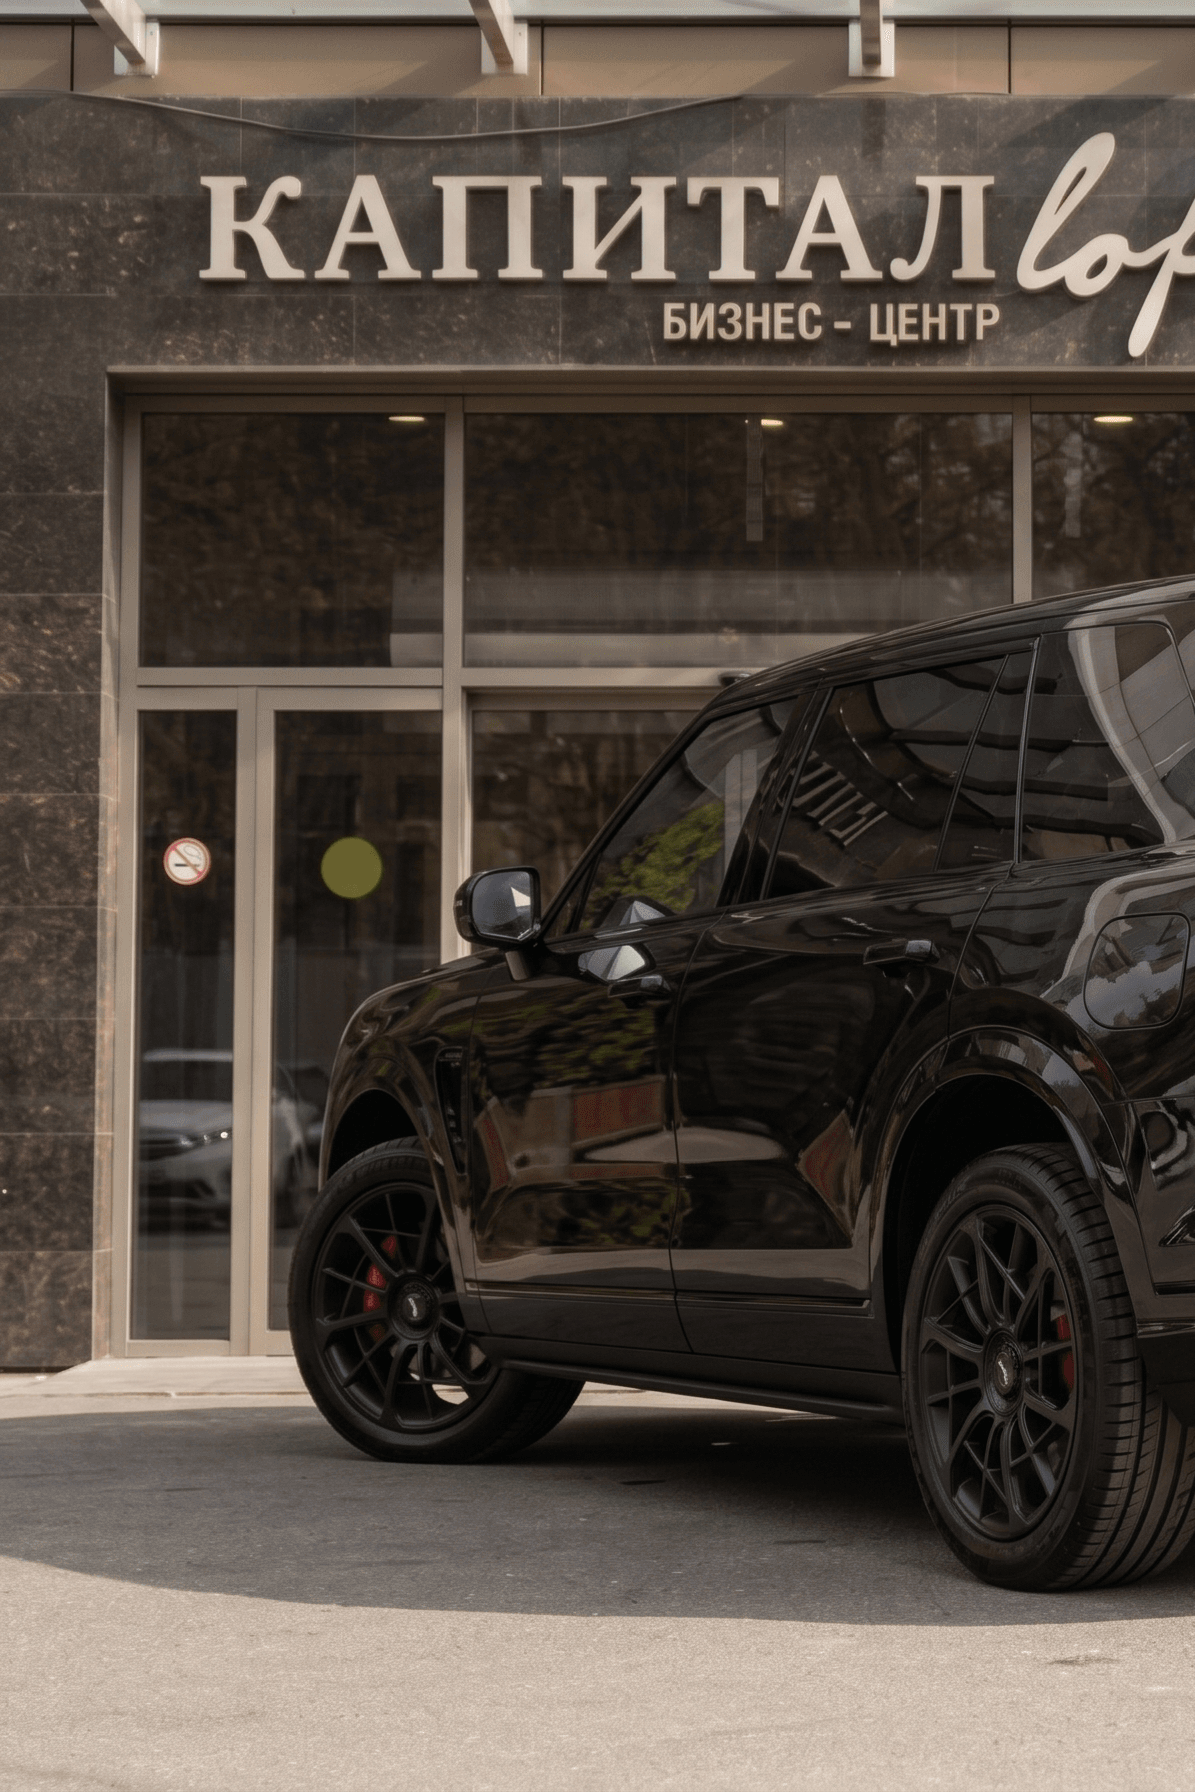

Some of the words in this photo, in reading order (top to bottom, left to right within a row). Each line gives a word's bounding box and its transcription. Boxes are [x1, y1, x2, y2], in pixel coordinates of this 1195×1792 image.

[199, 174, 996, 283] КАПИТАЛ
[663, 302, 822, 341] БИЗНЕС
[870, 303, 1000, 346] ЦЕНТР
